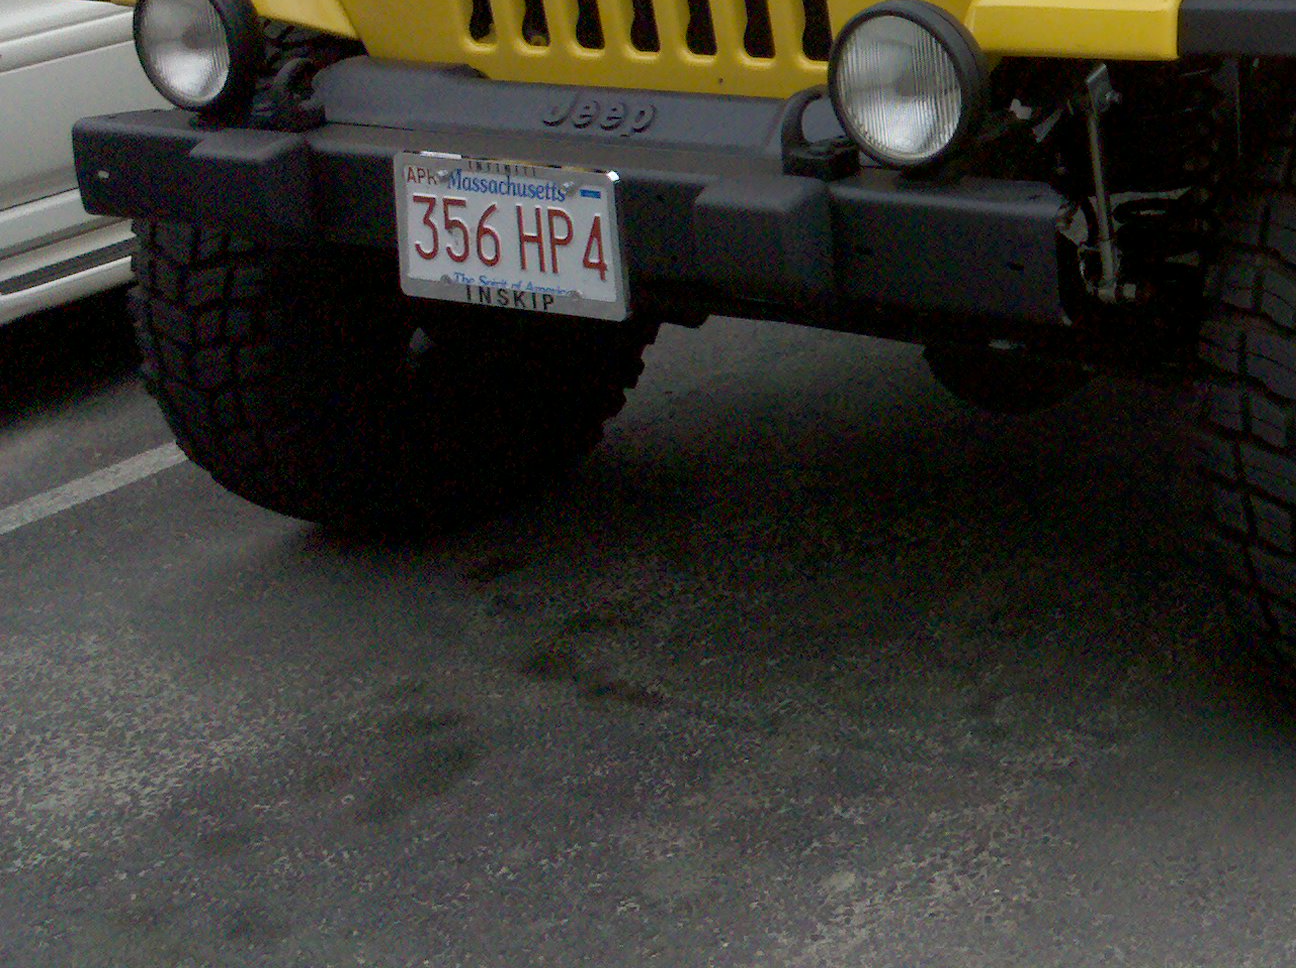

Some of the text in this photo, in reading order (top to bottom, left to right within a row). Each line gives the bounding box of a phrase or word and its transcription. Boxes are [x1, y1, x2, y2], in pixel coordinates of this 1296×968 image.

[541, 91, 658, 138] Jeep
[446, 168, 567, 203] Massachusetts
[413, 193, 608, 282] 356 HP4
[453, 271, 475, 284] The
[465, 284, 555, 311] INSKIP
